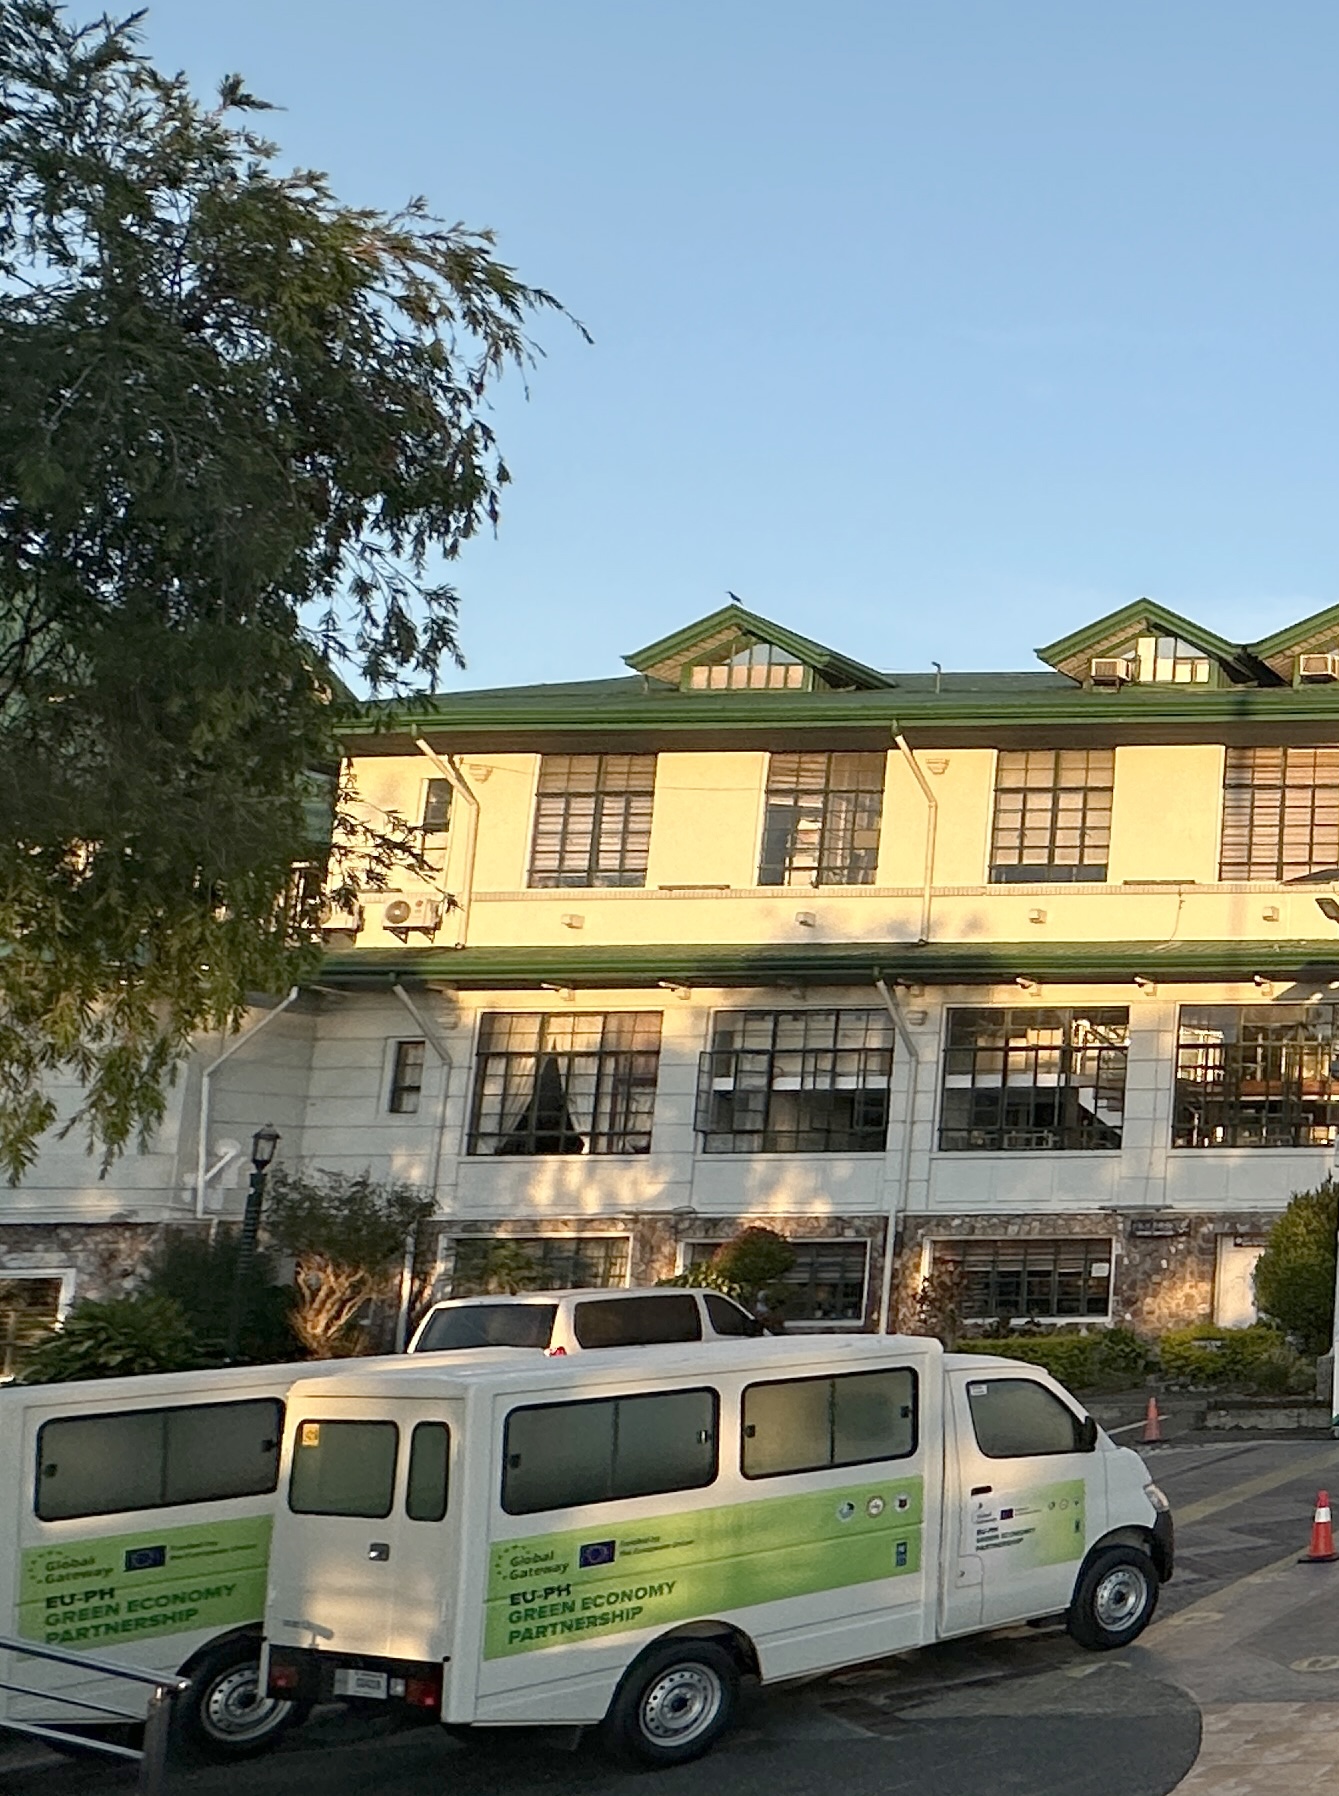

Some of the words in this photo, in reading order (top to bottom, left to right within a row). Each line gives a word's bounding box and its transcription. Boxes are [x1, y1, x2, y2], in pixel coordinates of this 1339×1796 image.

[45, 1555, 97, 1572] Global
[509, 1550, 555, 1568] Global
[44, 1566, 115, 1585] Gateway
[508, 1561, 570, 1582] Gateway
[44, 1602, 120, 1626] GREEN
[126, 1583, 237, 1612] ECONOMY
[46, 1587, 116, 1609] EU-PH
[508, 1599, 576, 1624] GREEN
[581, 1580, 677, 1611] ECONOMY
[509, 1583, 572, 1606] EU-PH
[45, 1607, 200, 1644] PARTNERSHIP
[507, 1605, 645, 1645] PARTNERSHIP
